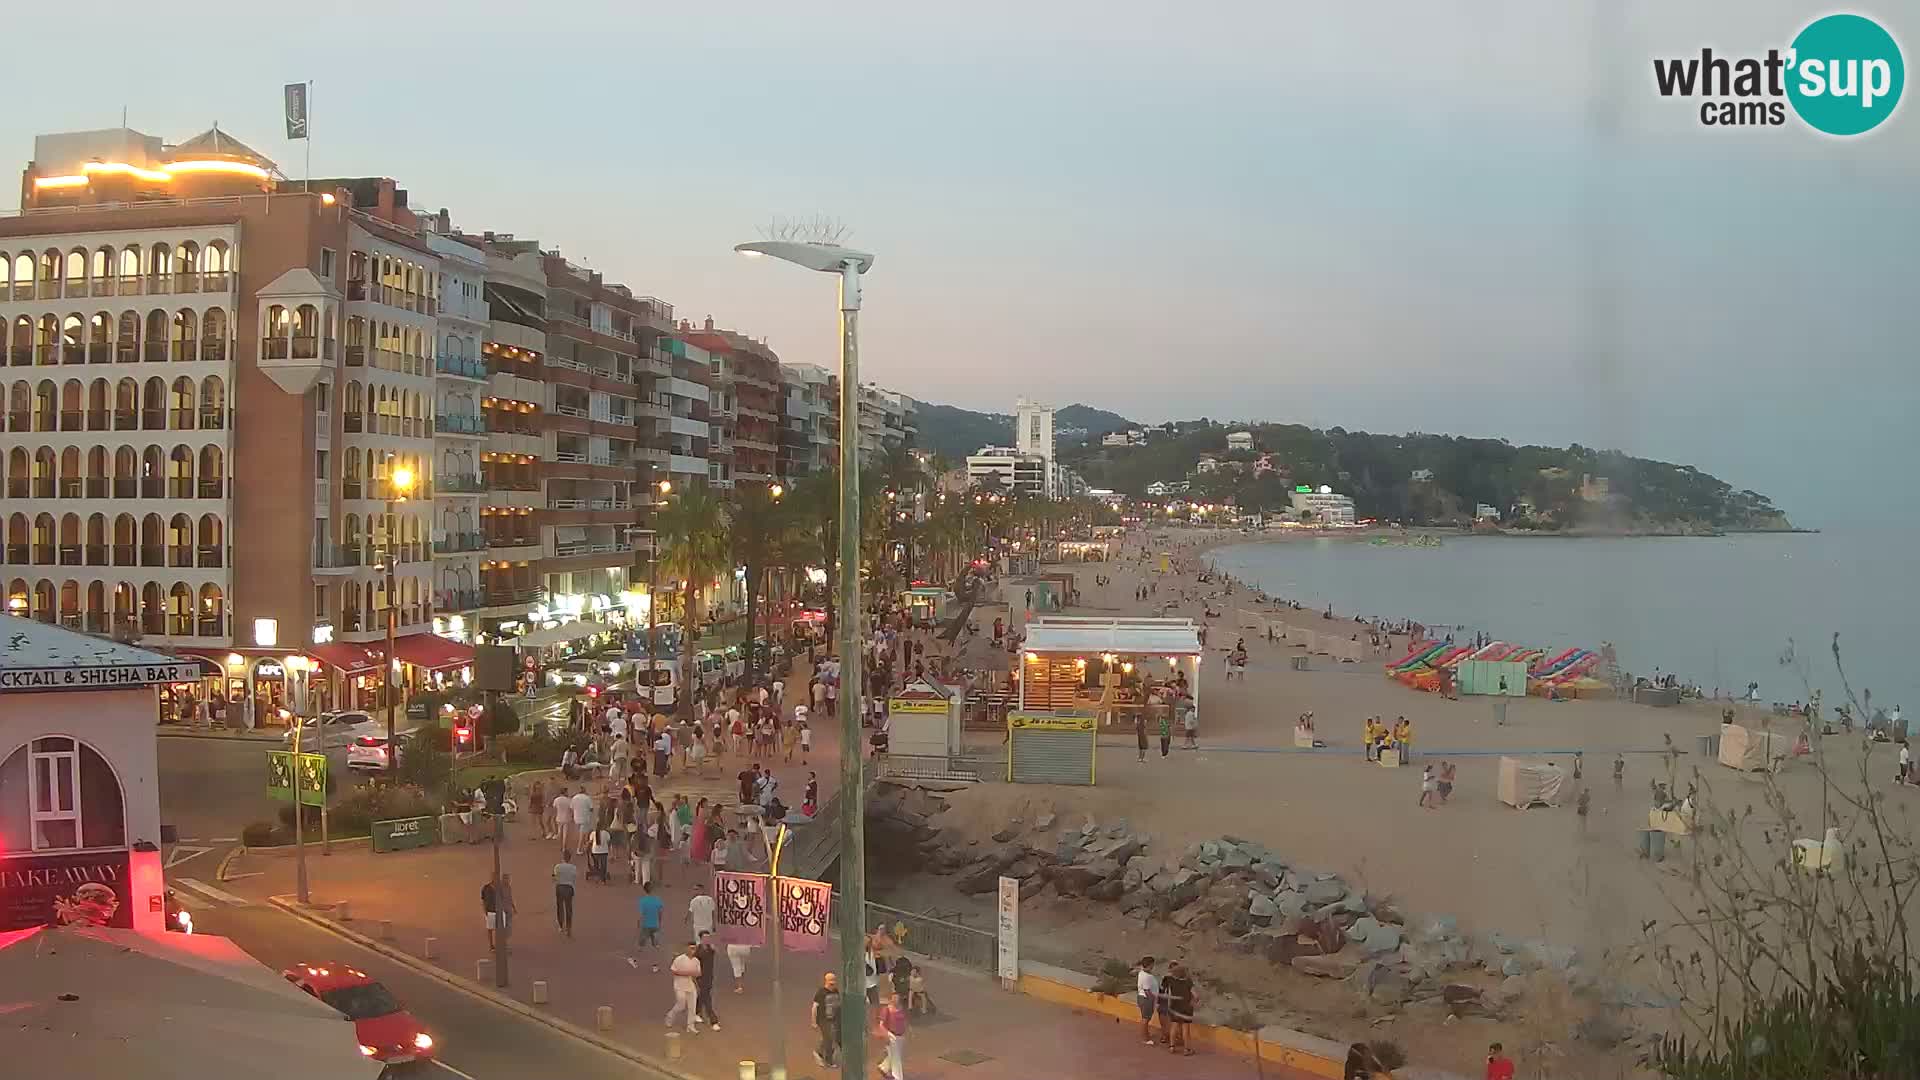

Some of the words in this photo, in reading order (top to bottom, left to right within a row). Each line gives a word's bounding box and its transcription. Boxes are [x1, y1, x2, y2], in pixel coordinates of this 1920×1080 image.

[64, 670, 75, 684] &
[80, 667, 143, 684] SHISHA
[147, 667, 178, 681] BAR
[258, 664, 282, 676] KFC
[0, 868, 59, 888] TAKE
[64, 864, 121, 884] AWAY
[717, 893, 754, 911] ENJOY
[780, 895, 818, 918] ENJOY
[718, 907, 764, 929] RESPECT
[781, 913, 827, 937] RESPECT
